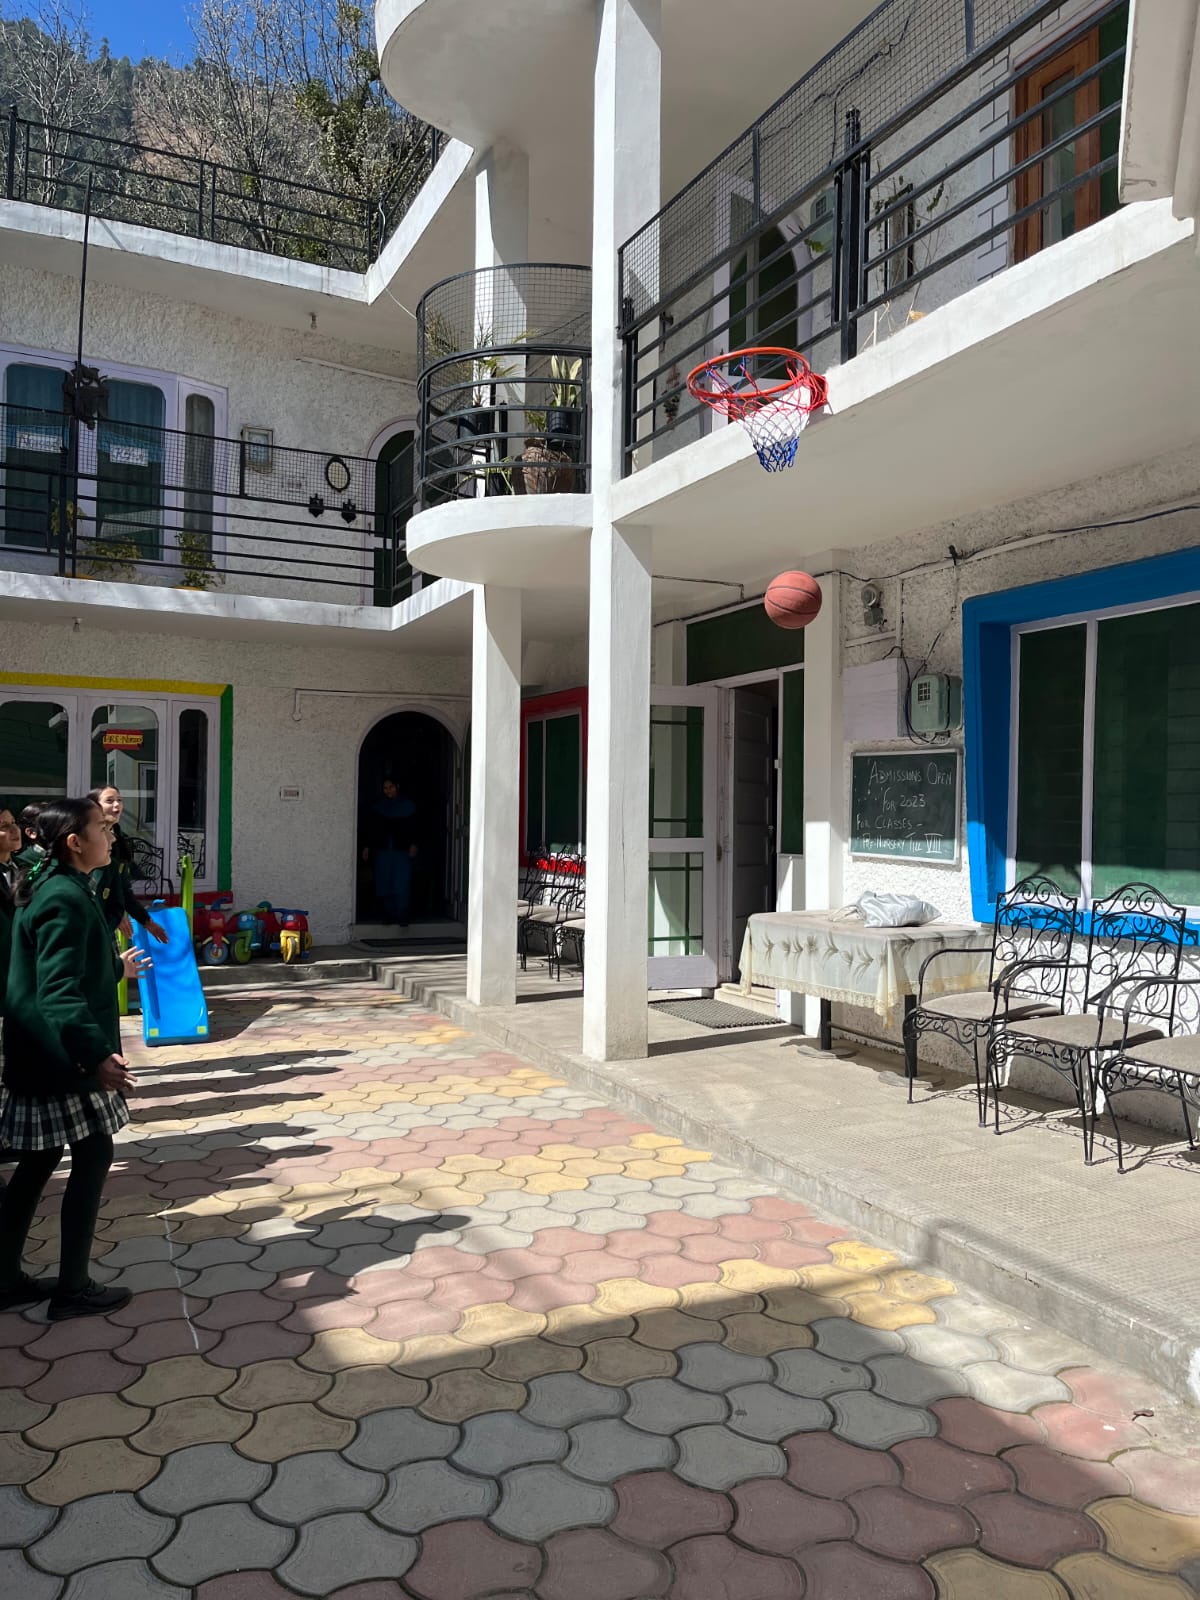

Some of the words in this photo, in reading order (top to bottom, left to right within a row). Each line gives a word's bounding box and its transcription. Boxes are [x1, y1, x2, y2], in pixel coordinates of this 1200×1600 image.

[869, 761, 922, 784] ADMISSIONS
[927, 762, 952, 785] OPEN
[883, 787, 897, 813] FOR
[900, 794, 926, 808] 2023
[856, 813, 871, 830] FOR
[875, 815, 913, 830] CLASSES
[904, 832, 923, 851] TILL
[924, 832, 944, 854] VIII
